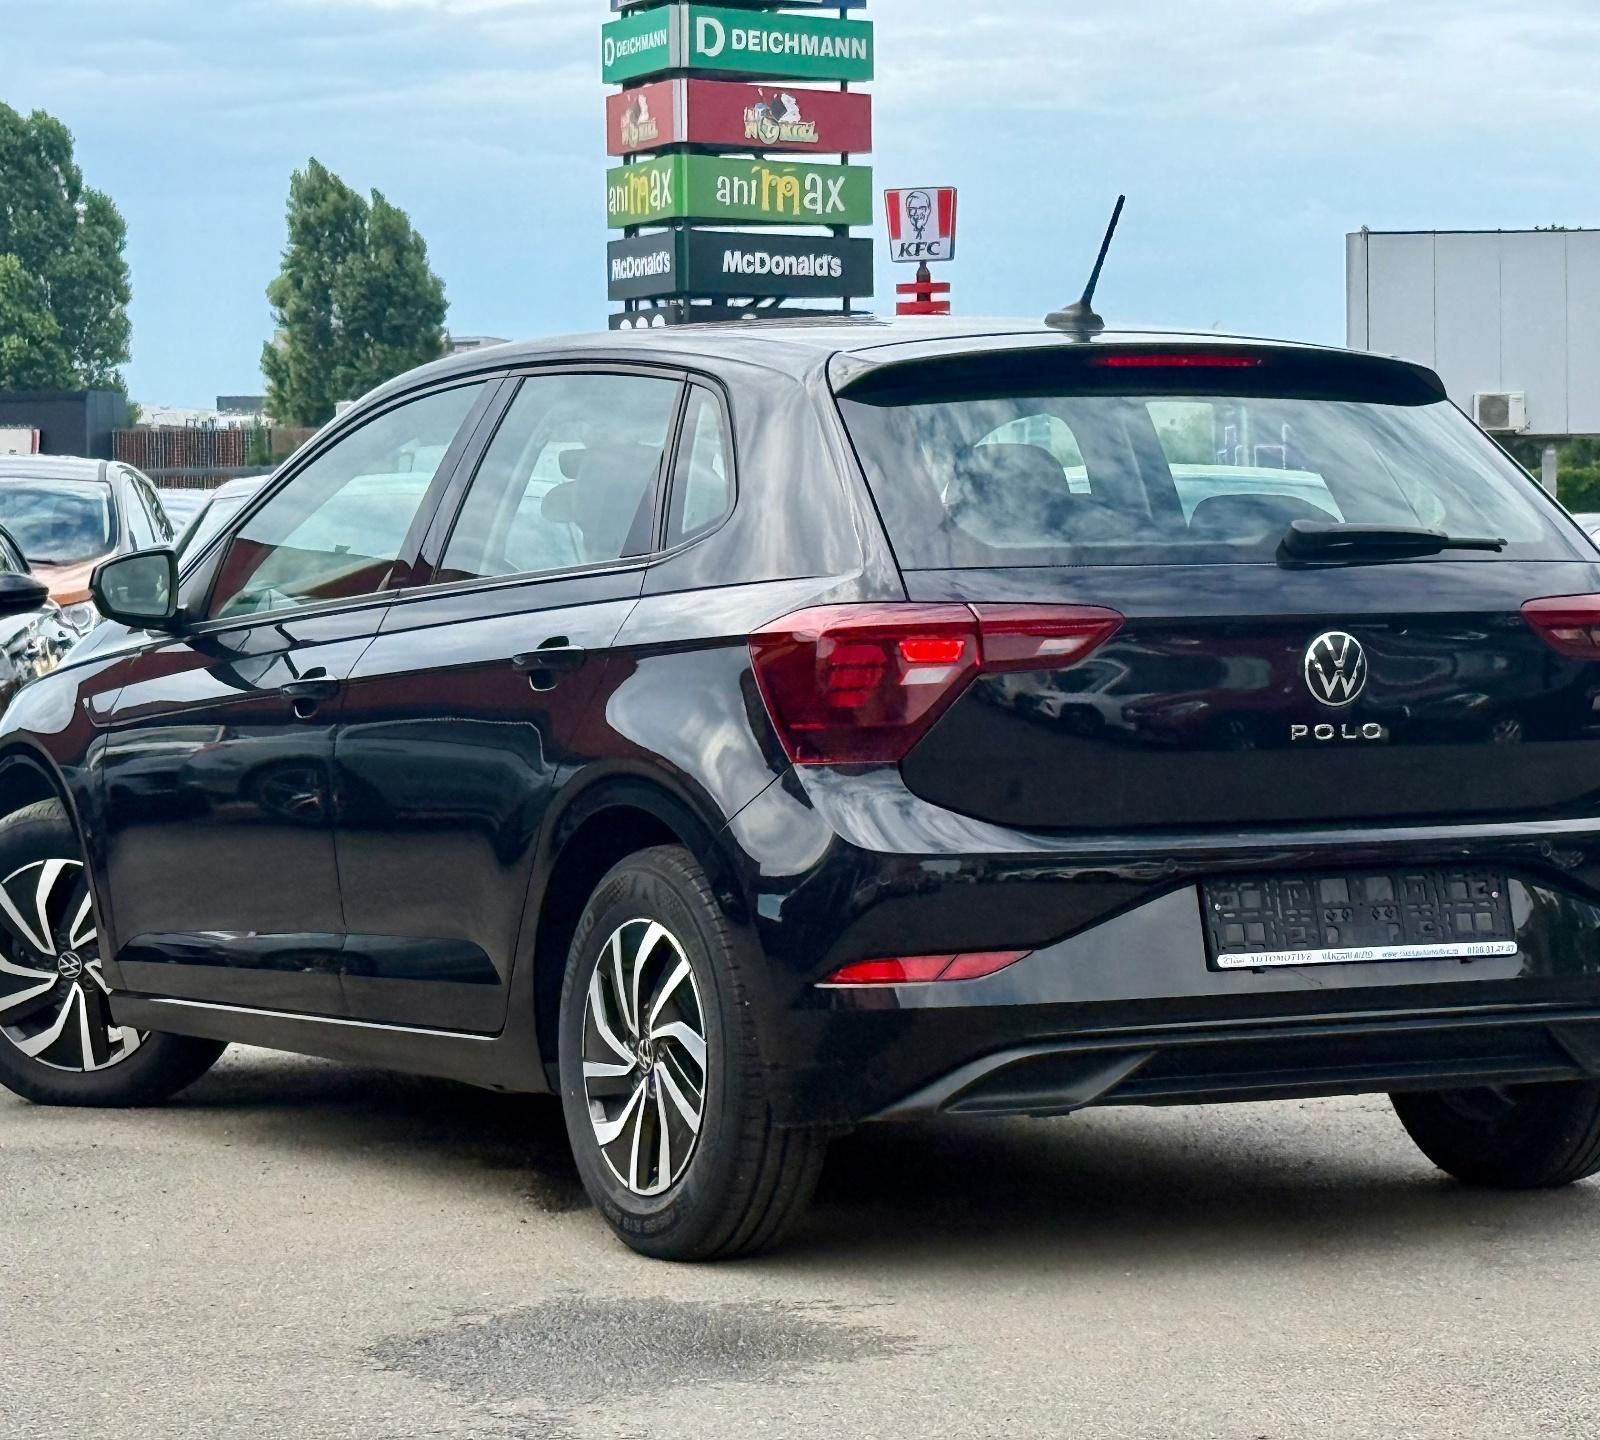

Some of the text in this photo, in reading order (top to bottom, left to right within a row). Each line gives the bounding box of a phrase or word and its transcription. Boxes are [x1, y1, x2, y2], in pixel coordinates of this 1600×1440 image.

[616, 28, 667, 58] DEICHMANN
[696, 16, 867, 60] D DEICHMANN
[608, 167, 672, 216] animax
[716, 166, 846, 215] animax
[722, 249, 843, 278] McDonald's
[898, 241, 941, 258] KFC
[611, 251, 671, 282] McDonald's
[1290, 723, 1383, 741] POLO
